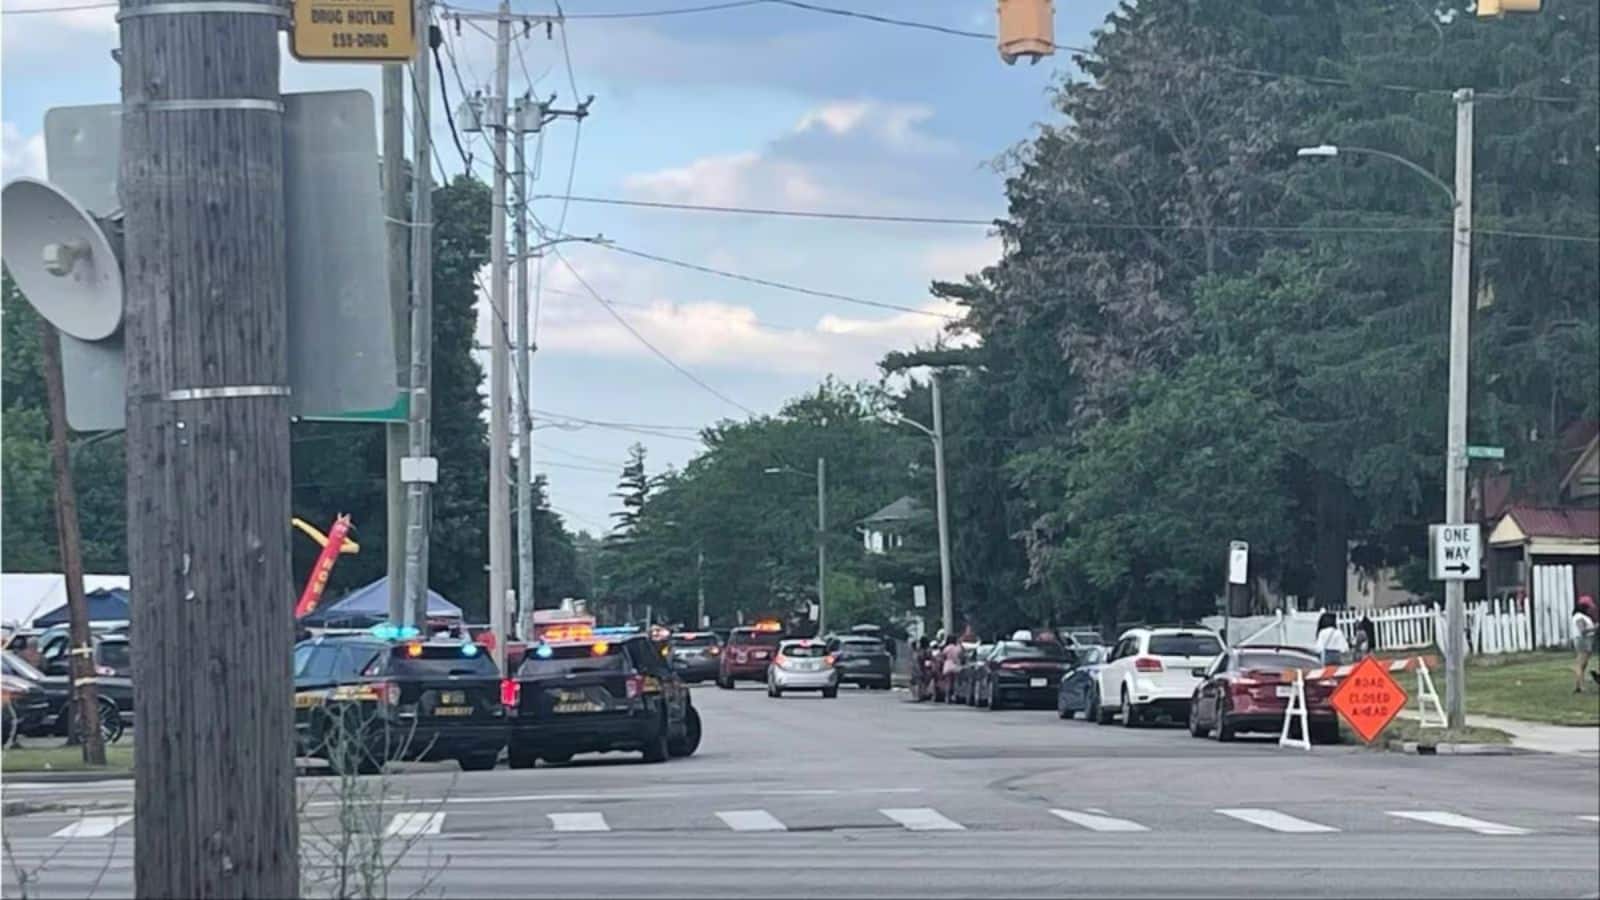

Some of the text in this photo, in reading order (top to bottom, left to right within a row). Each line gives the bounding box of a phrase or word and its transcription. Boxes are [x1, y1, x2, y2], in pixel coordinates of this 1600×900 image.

[311, 9, 395, 25] DRUG HOTLINE
[1443, 527, 1471, 542] ONE
[1444, 545, 1471, 560] WAY
[1355, 677, 1385, 688] ROAD
[1349, 692, 1391, 703] CLOSED
[1352, 706, 1387, 716] AHEAD
